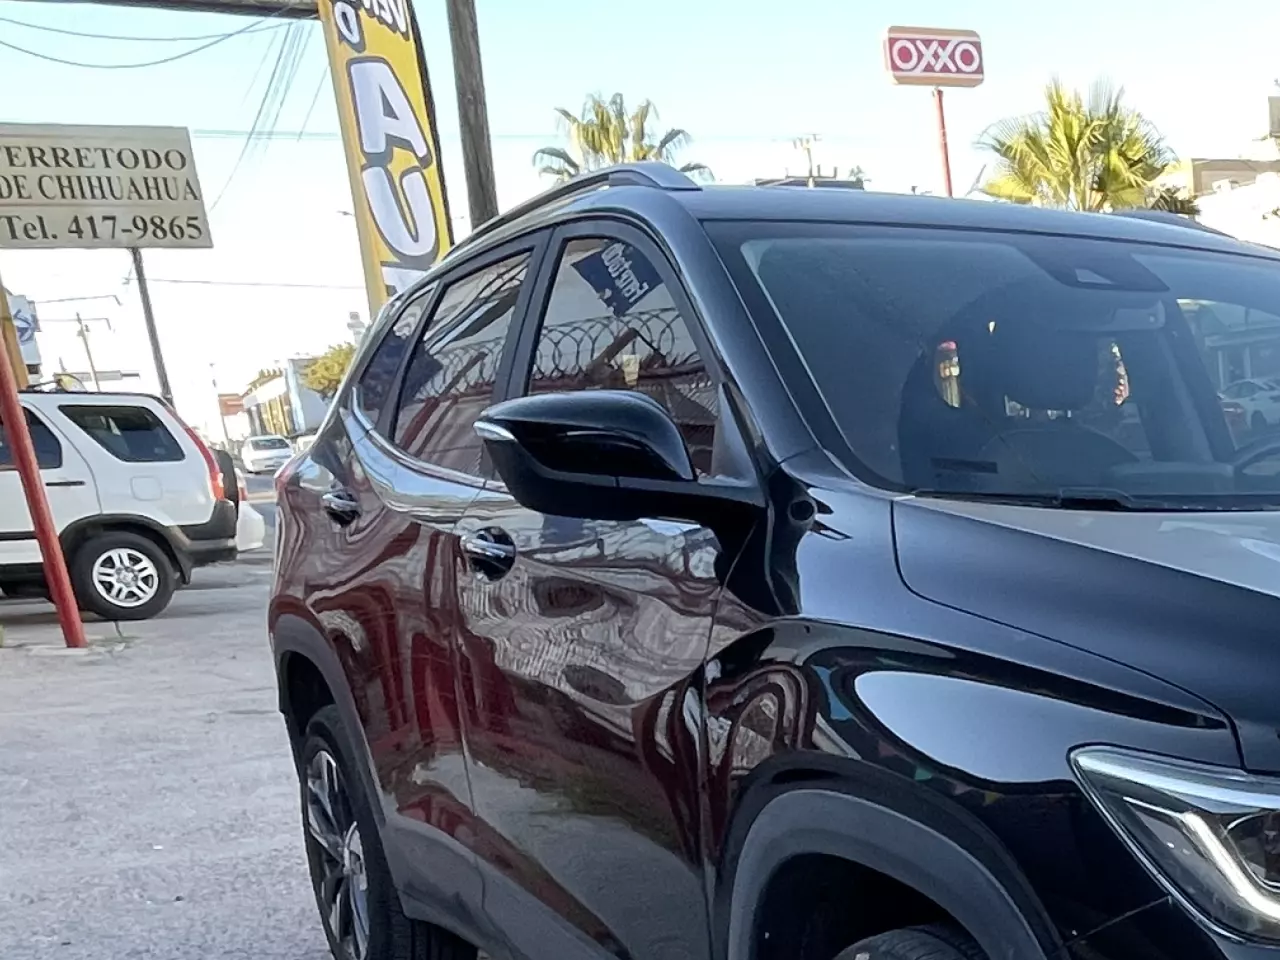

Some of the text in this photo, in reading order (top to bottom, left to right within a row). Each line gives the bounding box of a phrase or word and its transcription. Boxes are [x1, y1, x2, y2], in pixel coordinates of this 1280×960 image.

[892, 39, 981, 73] OXXO
[0, 145, 187, 171] ERRETODO
[0, 174, 201, 201] DE CHIHUAHUA
[0, 214, 203, 241] Tel. 417-9865
